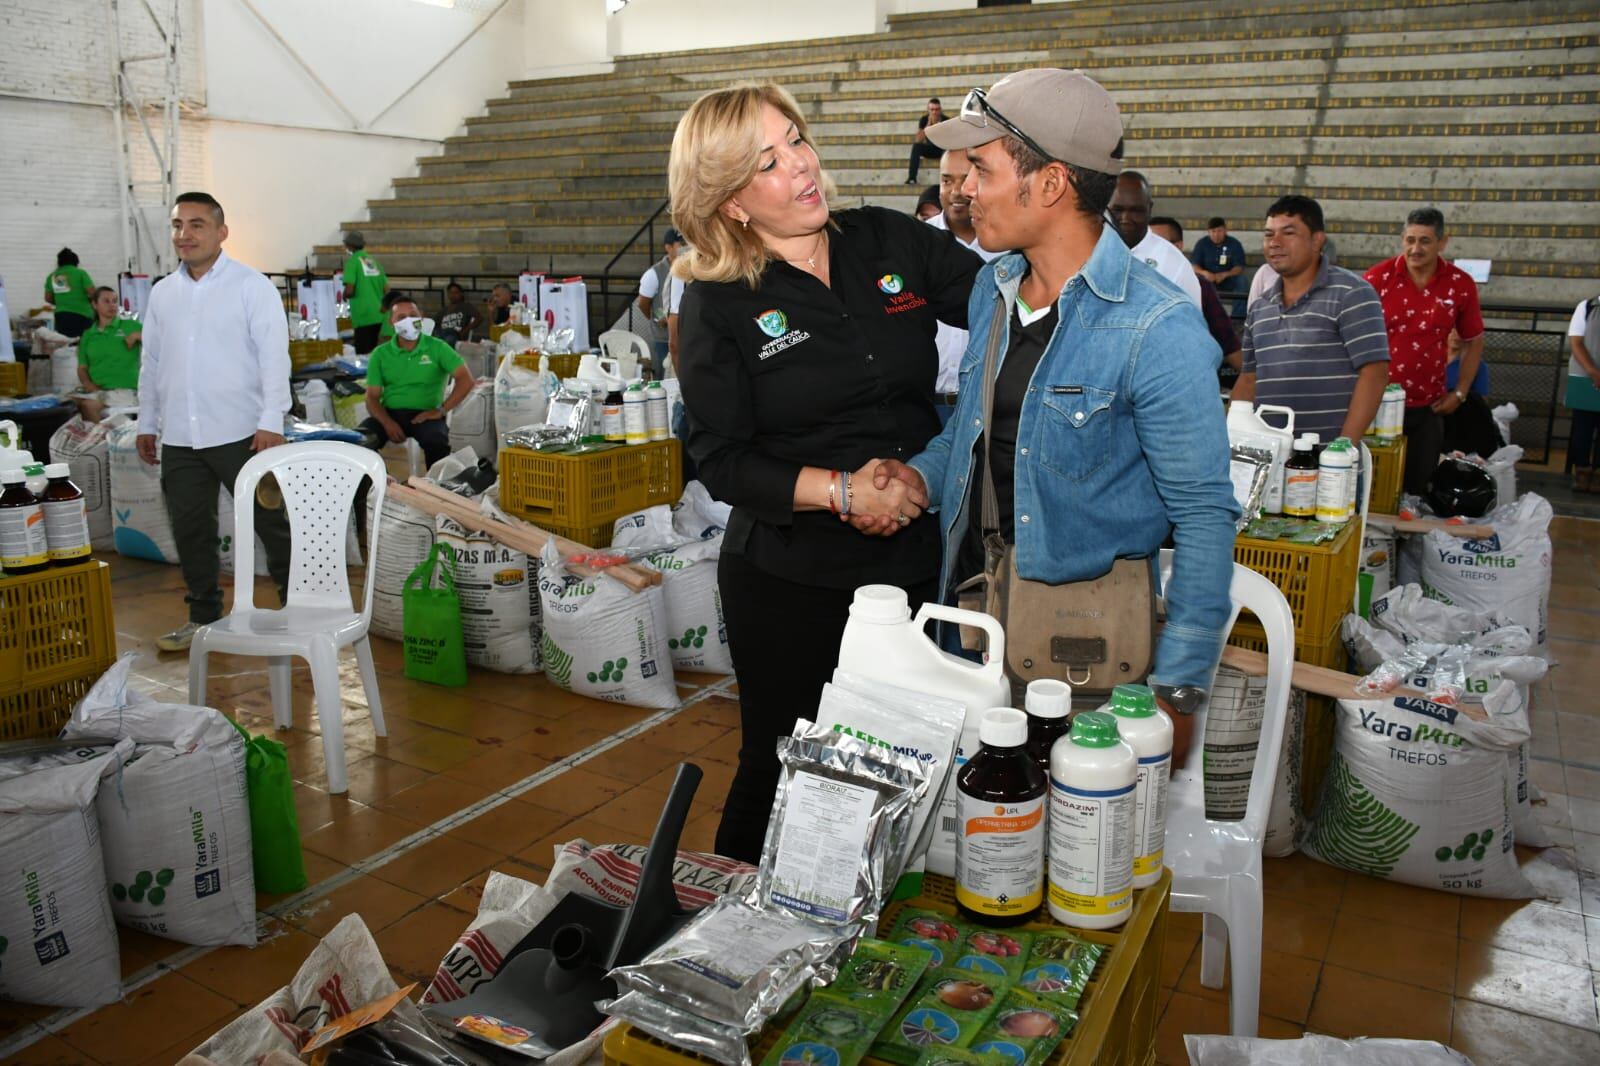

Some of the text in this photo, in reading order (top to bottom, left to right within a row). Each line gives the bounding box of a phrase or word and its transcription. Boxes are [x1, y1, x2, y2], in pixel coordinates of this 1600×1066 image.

[890, 292, 914, 304] Valle
[758, 347, 777, 359] VALLE
[789, 331, 811, 344] CAUCA
[1439, 549, 1516, 569] YaraMila
[1388, 747, 1448, 766] TREFOS
[1442, 879, 1483, 889] 50 kg
